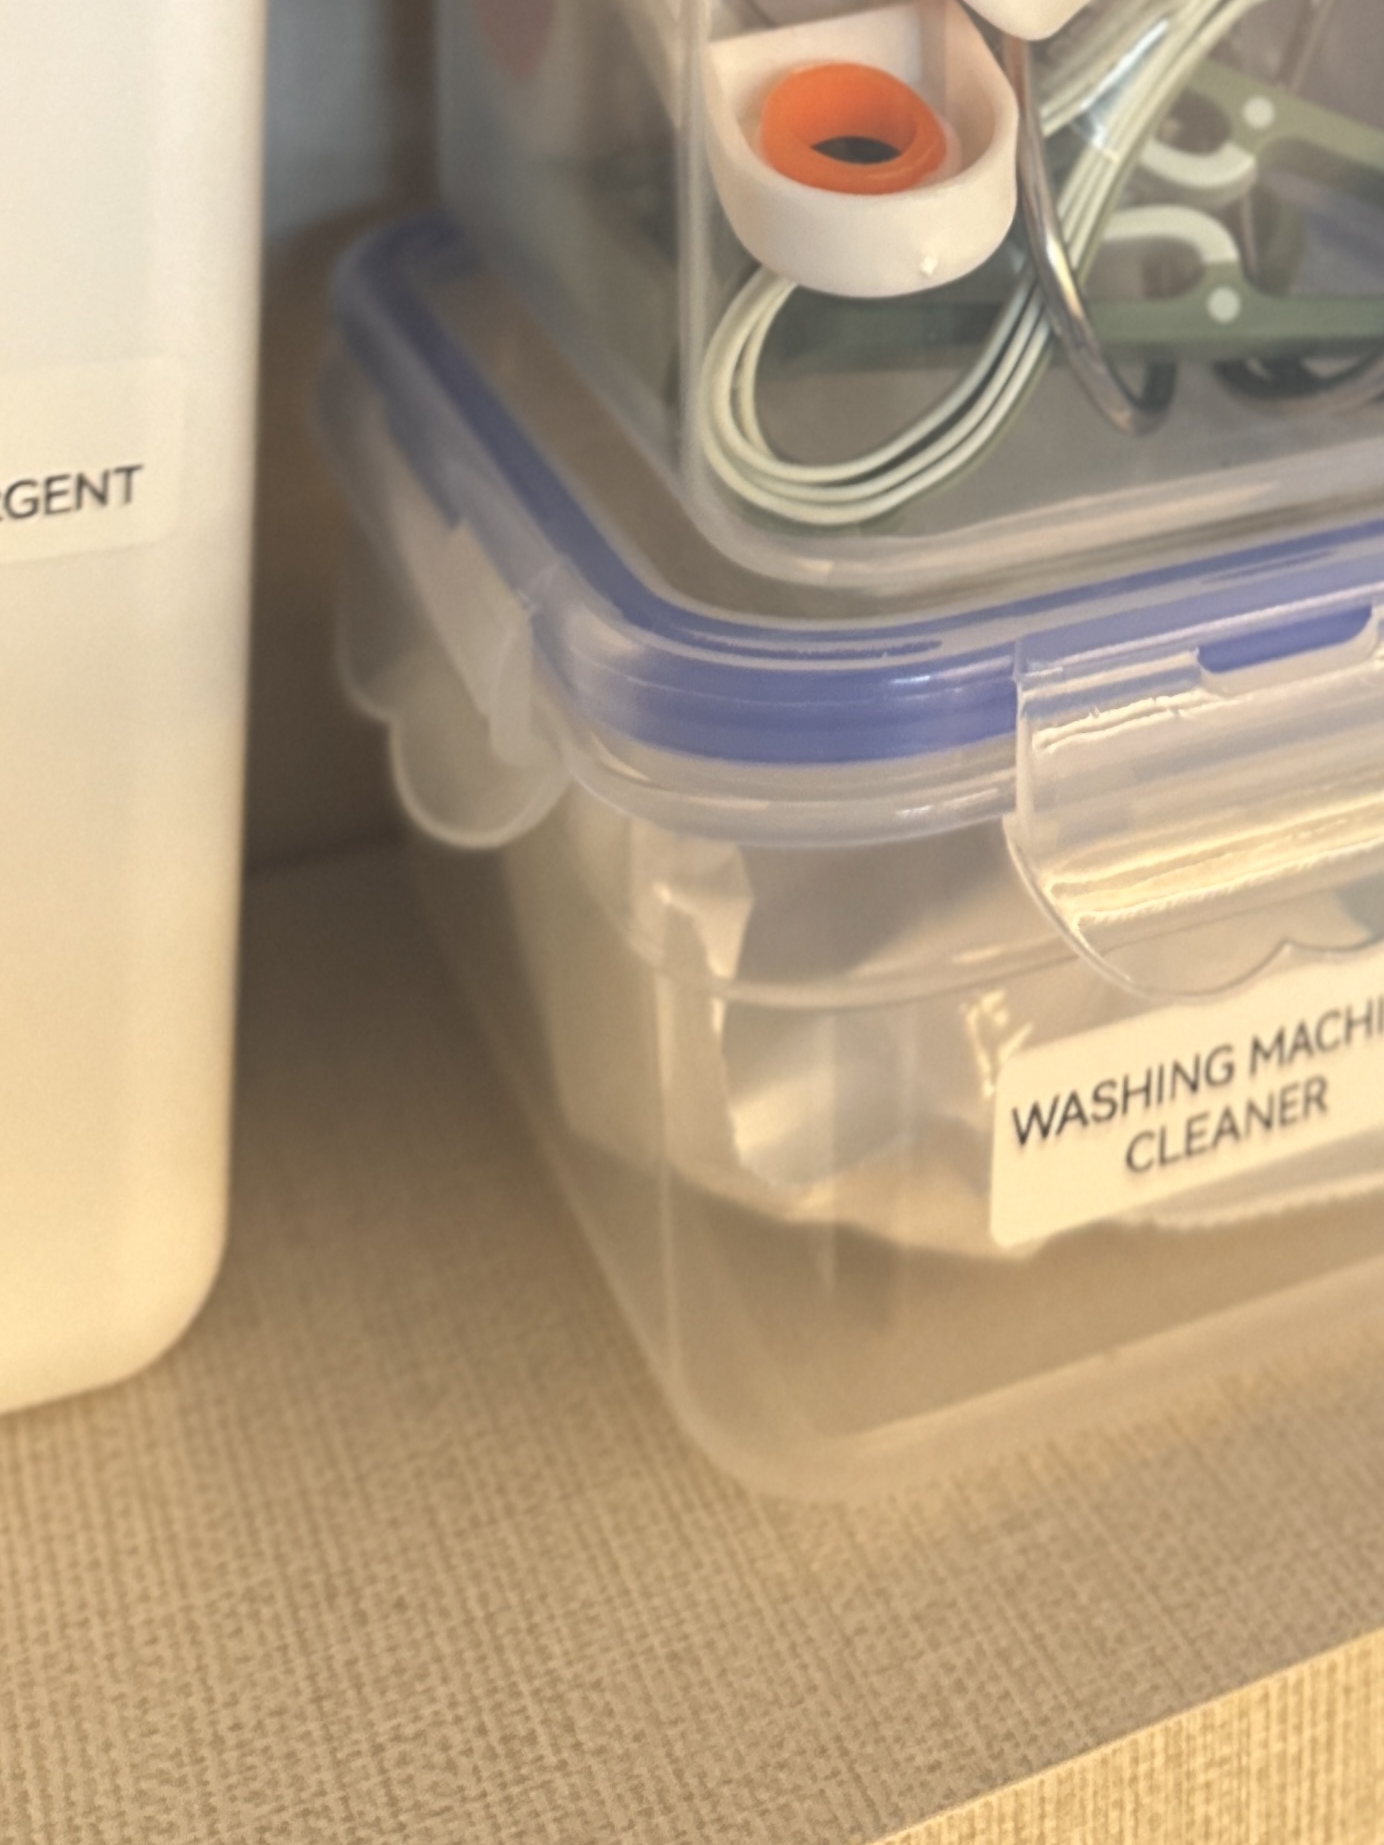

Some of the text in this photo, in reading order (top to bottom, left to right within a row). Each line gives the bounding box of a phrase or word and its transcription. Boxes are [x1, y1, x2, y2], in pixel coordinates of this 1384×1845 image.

[0, 463, 144, 522] GENT
[1011, 1044, 1236, 1147] WASHING
[1124, 1073, 1331, 1174] CLEANER
